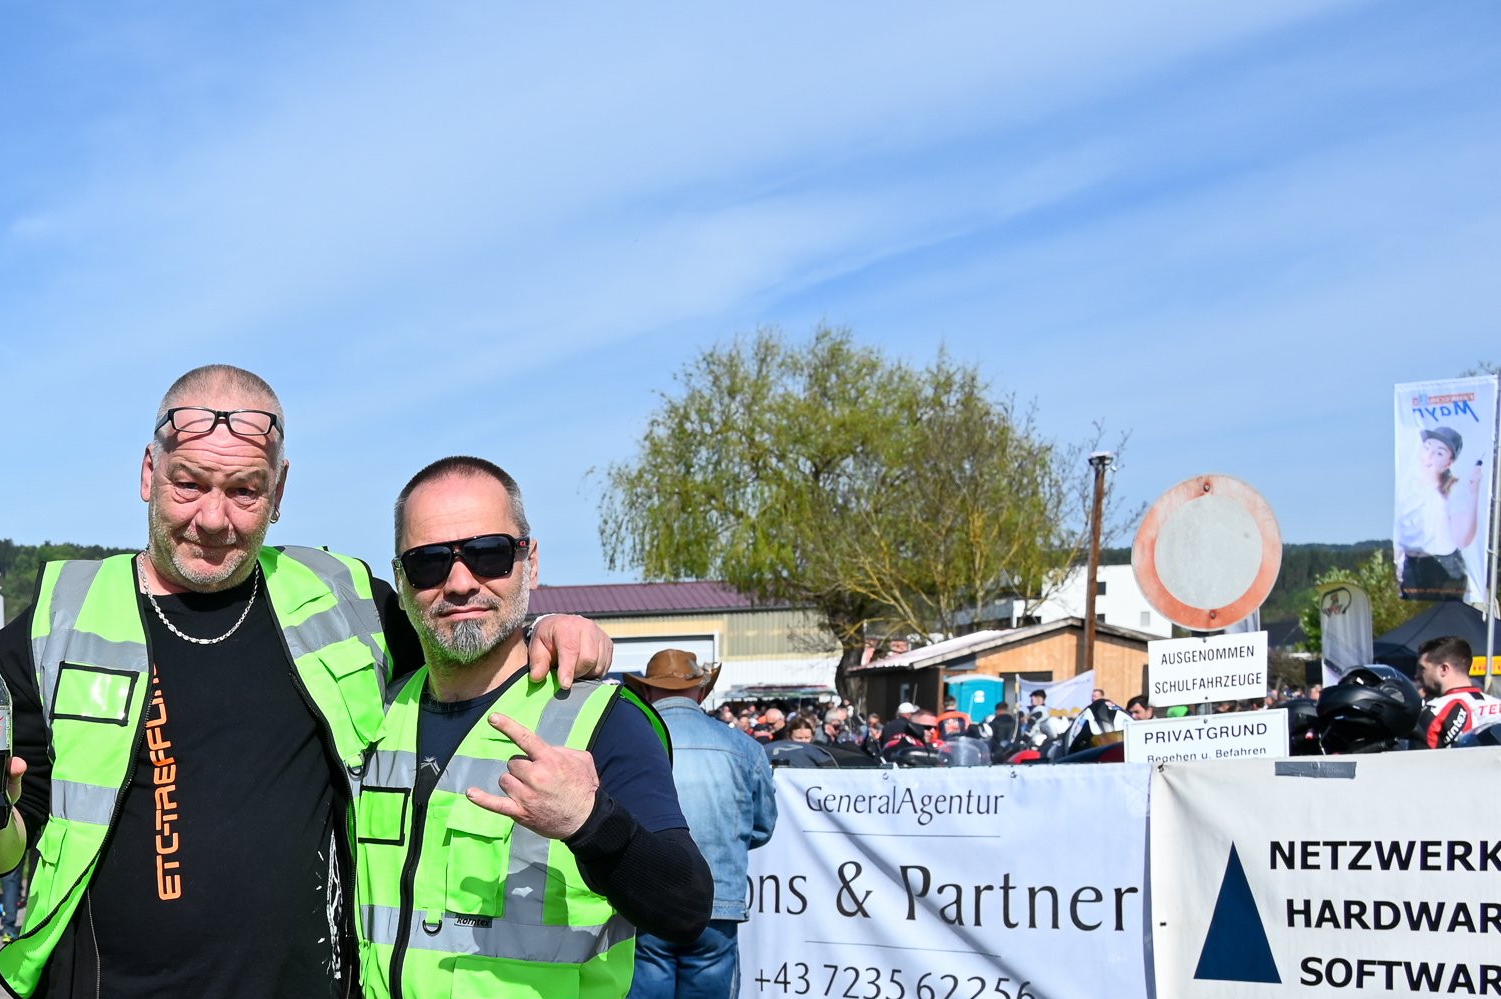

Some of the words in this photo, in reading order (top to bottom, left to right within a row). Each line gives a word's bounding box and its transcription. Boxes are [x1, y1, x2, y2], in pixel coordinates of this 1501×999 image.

[1161, 645, 1254, 665] AUSGENOMMEN
[1154, 672, 1262, 694] SCHULFAHRZEUGE
[1144, 723, 1267, 744] PRIVATGRUND
[1147, 753, 1197, 763] Begehen
[1201, 752, 1211, 760] u.
[1215, 747, 1267, 759] Befahren
[805, 785, 1005, 826] GeneralAgentur
[1270, 840, 1501, 872] NETZWERK
[835, 860, 874, 919] &
[899, 864, 1138, 932] Partner
[755, 961, 811, 996] +43
